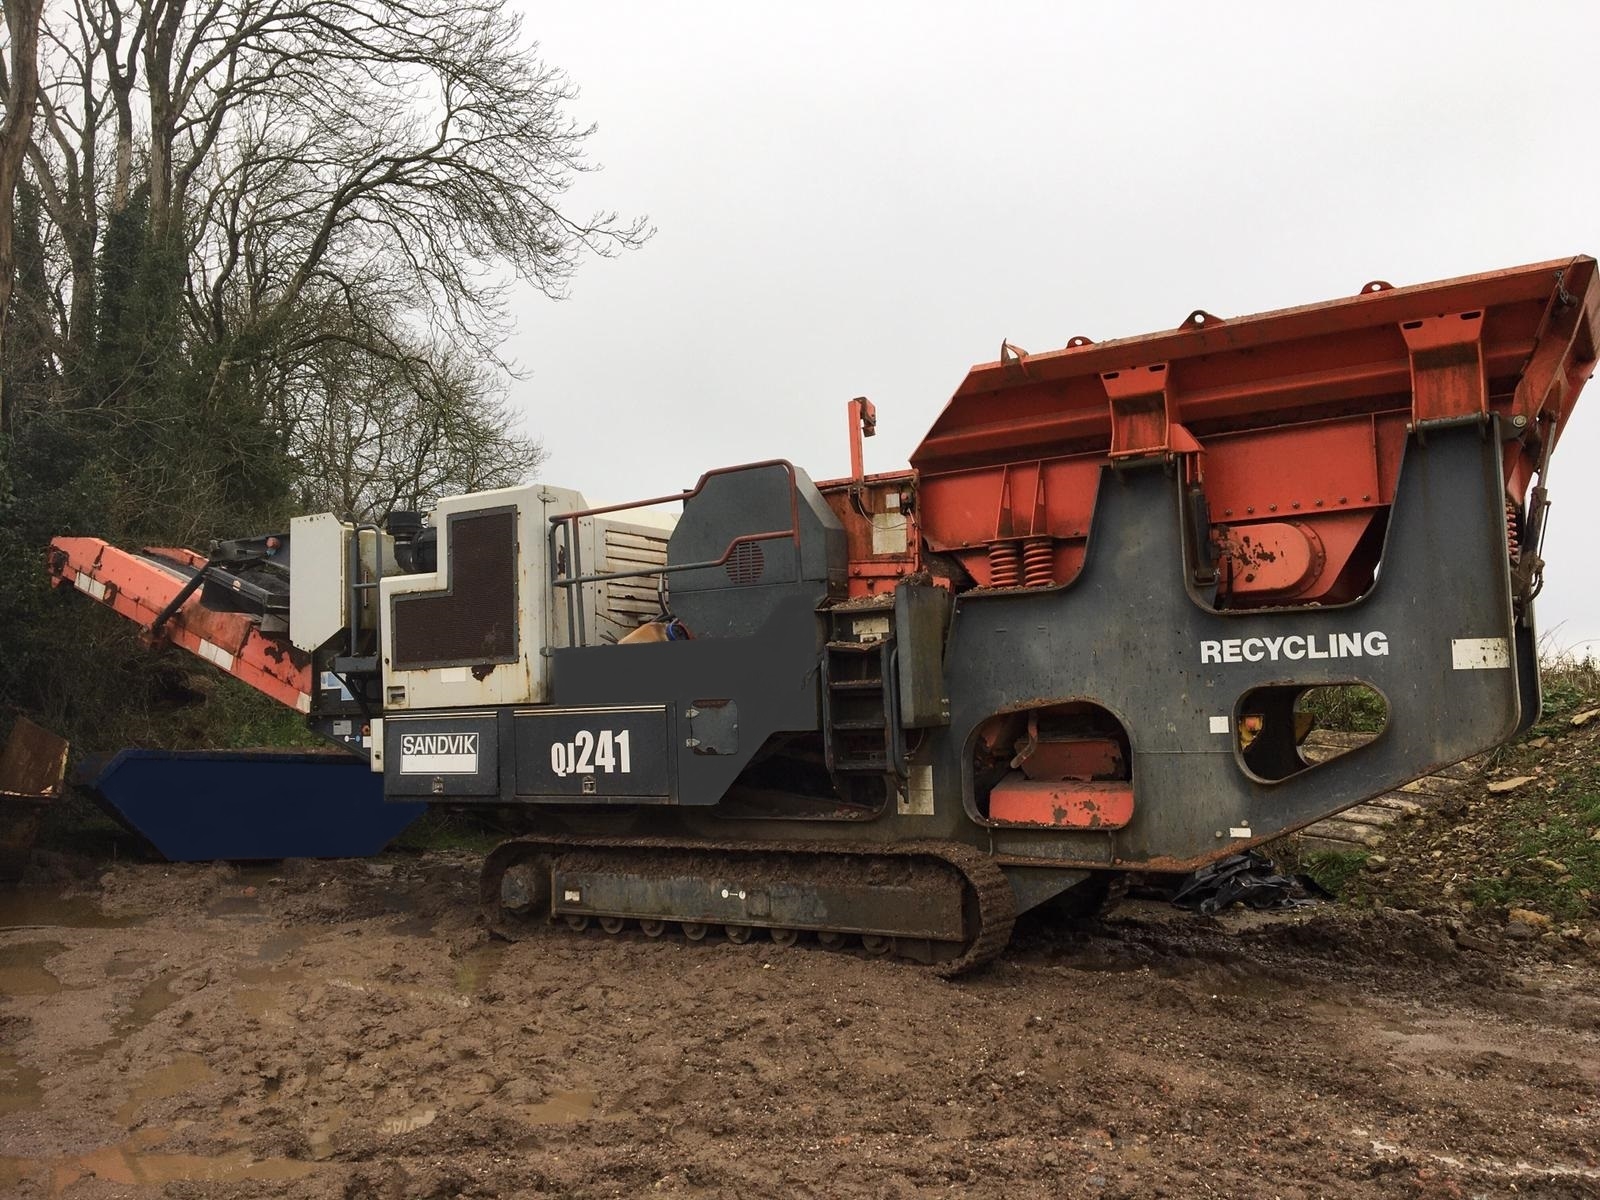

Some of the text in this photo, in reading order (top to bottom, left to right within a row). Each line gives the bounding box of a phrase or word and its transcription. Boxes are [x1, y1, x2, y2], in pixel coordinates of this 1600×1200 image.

[1200, 631, 1390, 664] RECYCLING
[403, 735, 476, 755] SANDVIK
[551, 730, 631, 777] QJ241
